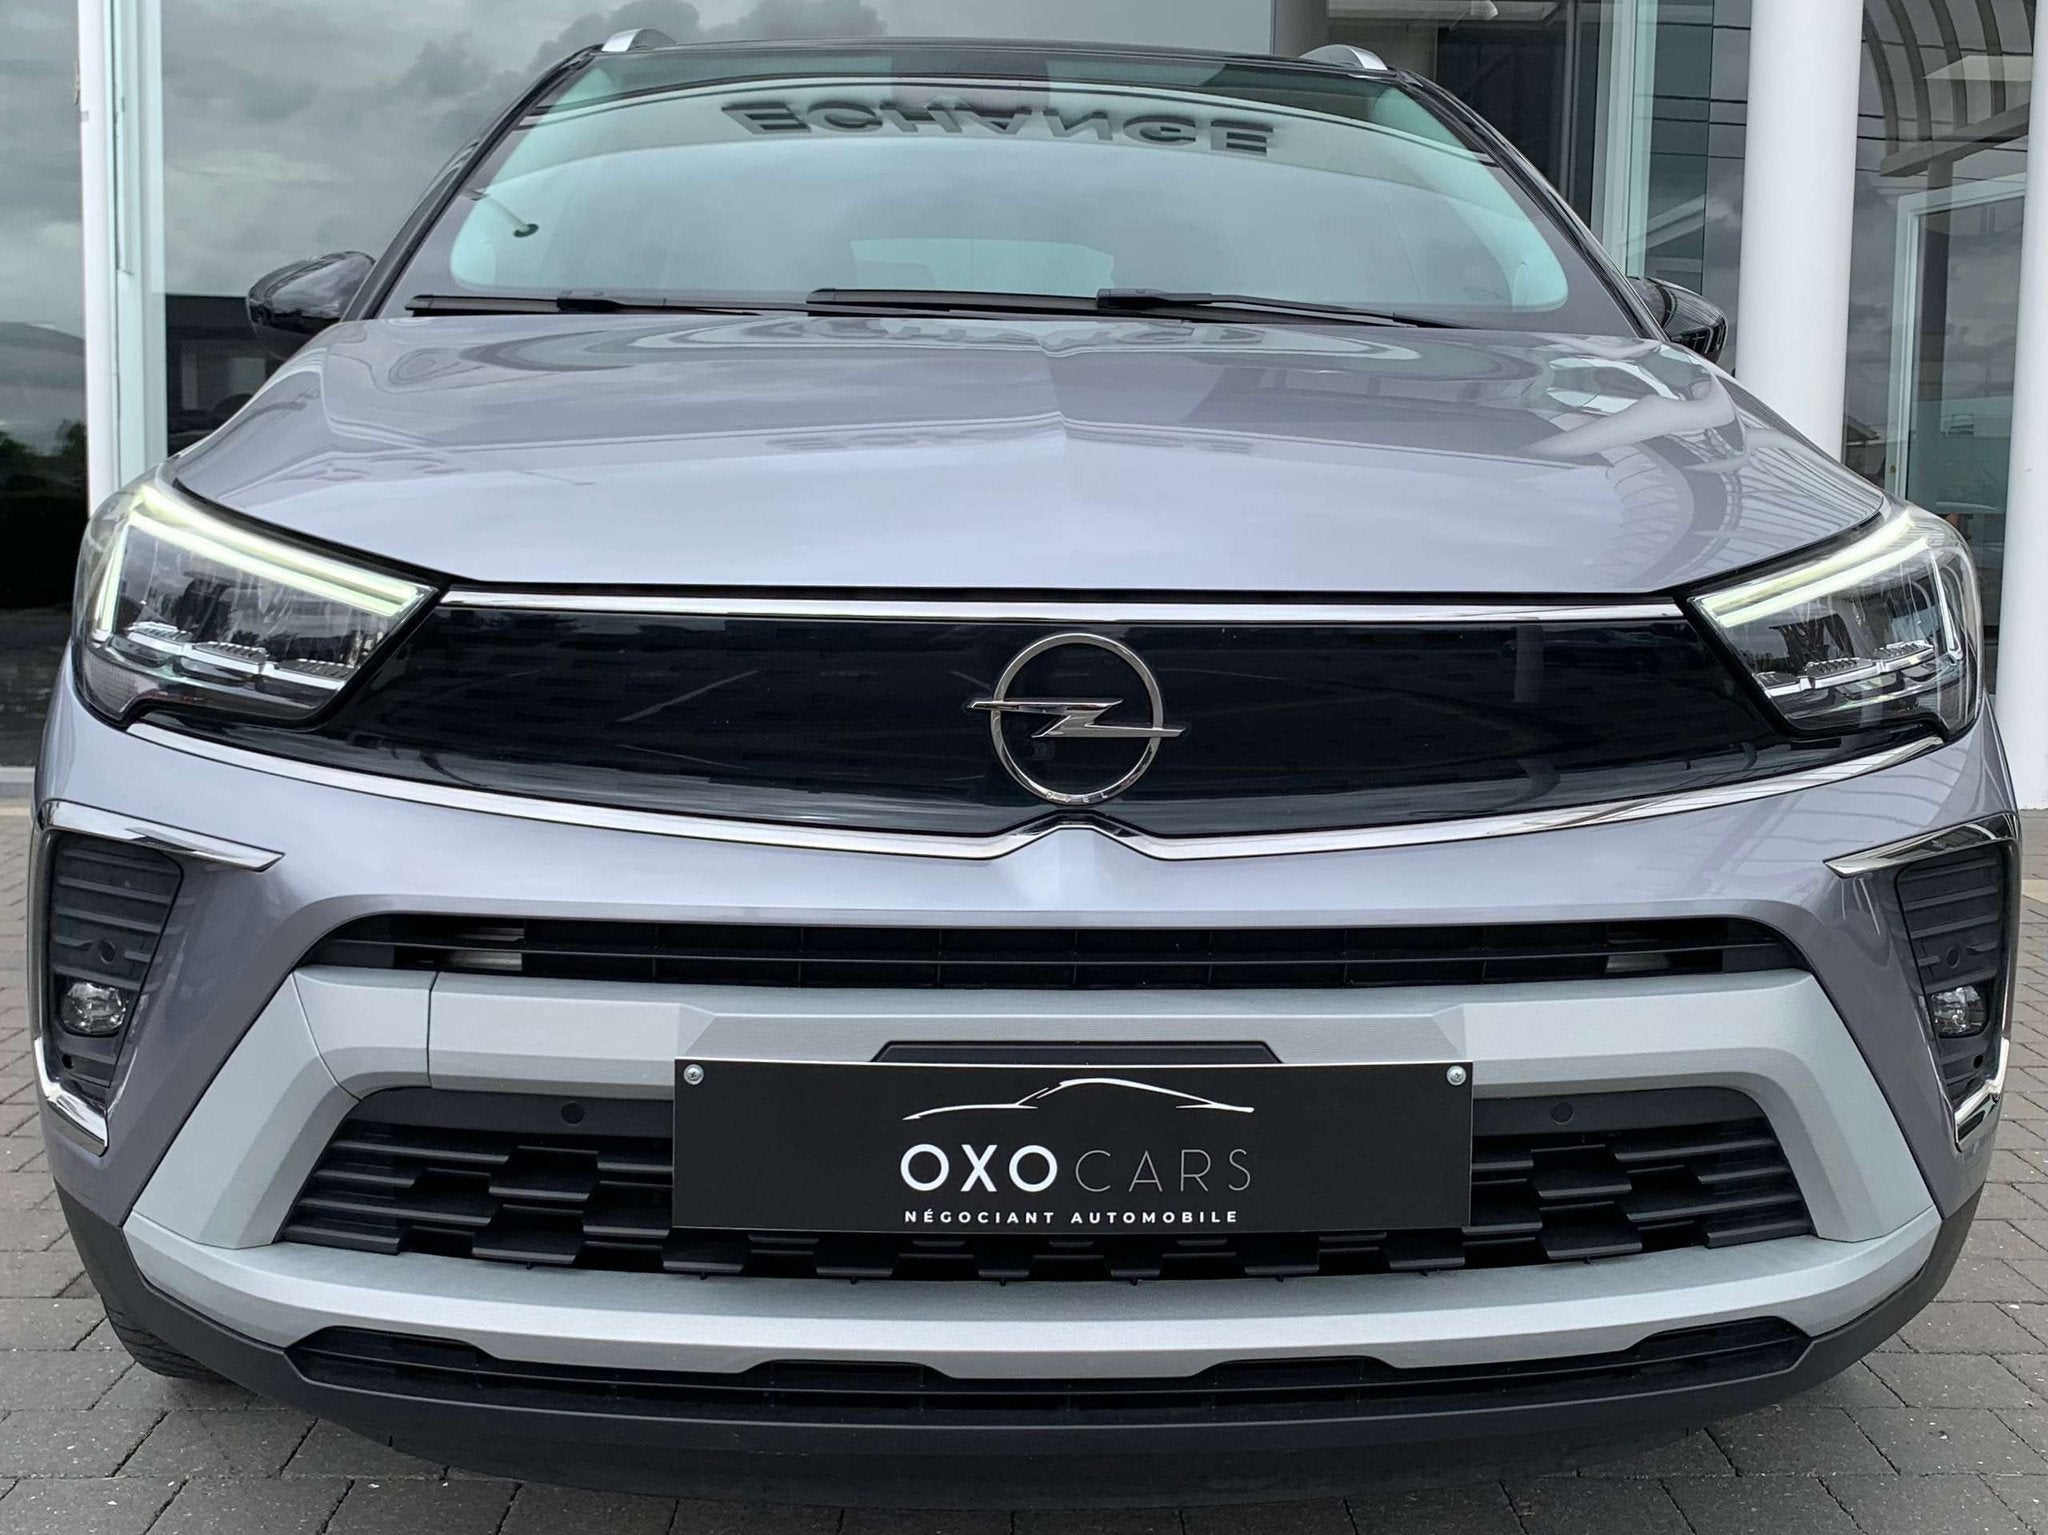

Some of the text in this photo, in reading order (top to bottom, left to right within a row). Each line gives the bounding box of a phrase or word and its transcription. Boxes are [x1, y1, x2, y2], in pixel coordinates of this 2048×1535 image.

[900, 1143, 1252, 1193] OXO CARS
[904, 1208, 1238, 1224] NÉGOCIANT AUTOMOBILE
